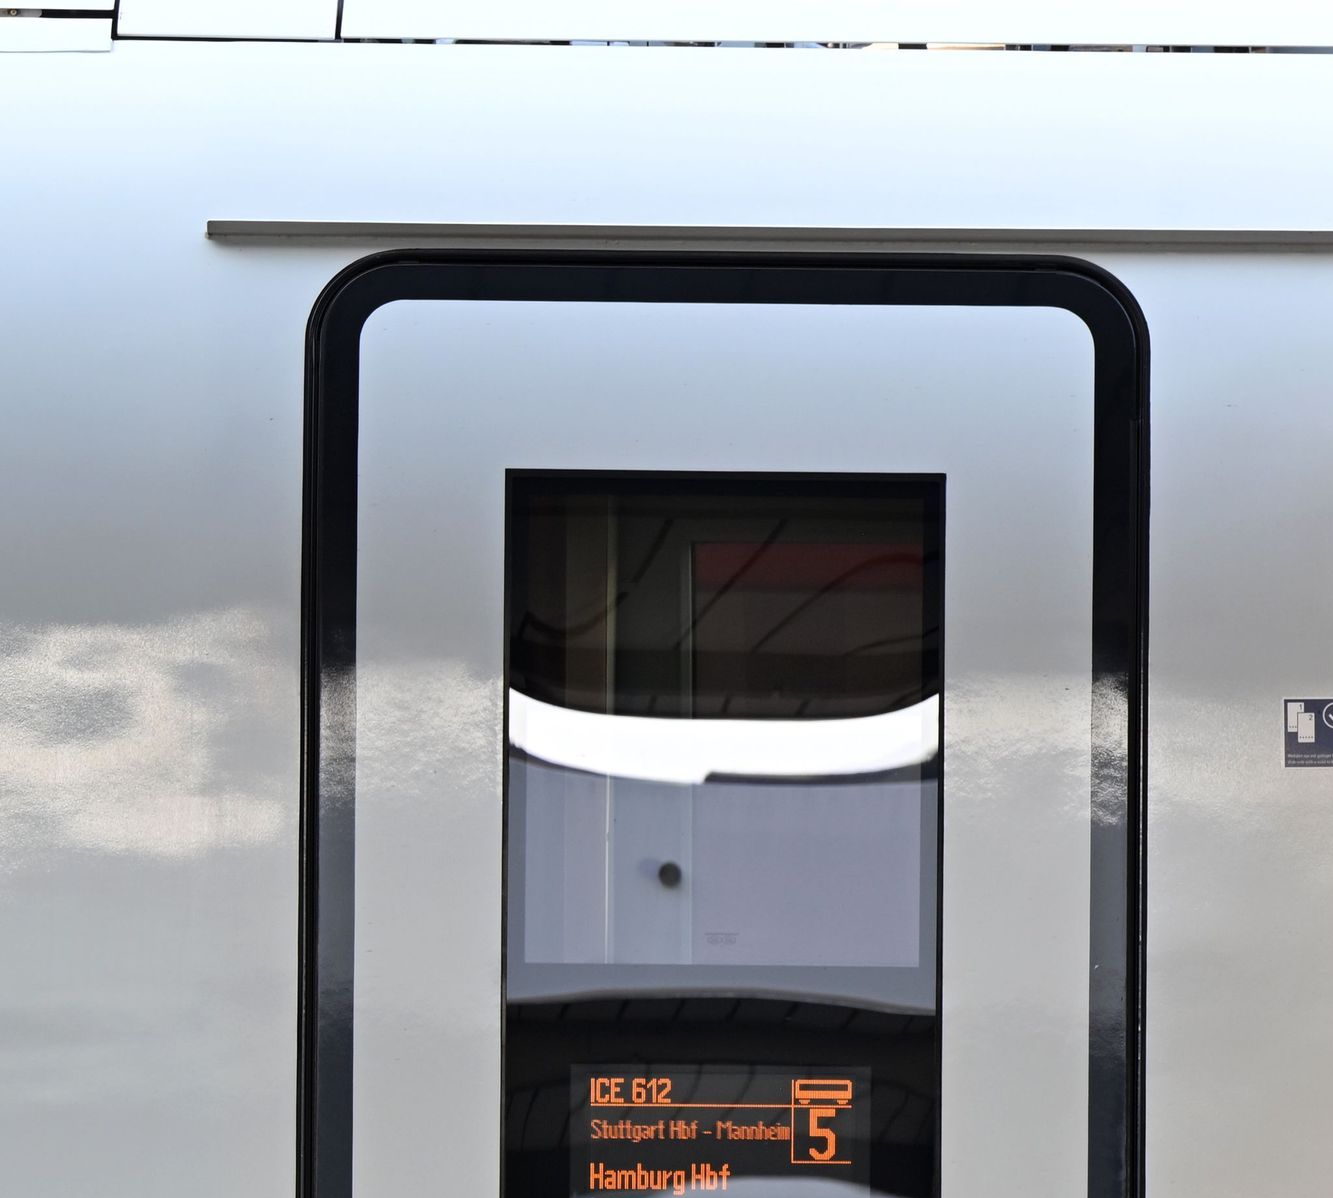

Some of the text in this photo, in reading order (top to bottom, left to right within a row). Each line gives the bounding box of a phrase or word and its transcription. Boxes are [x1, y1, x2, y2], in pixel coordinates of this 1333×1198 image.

[590, 1077, 672, 1104] ICE 612
[590, 1119, 666, 1143] Stuttgart
[669, 1119, 698, 1140] Hbf
[715, 1120, 791, 1141] Mannheim
[808, 1107, 836, 1161] 5
[589, 1162, 731, 1196] Hamburg Hbf
